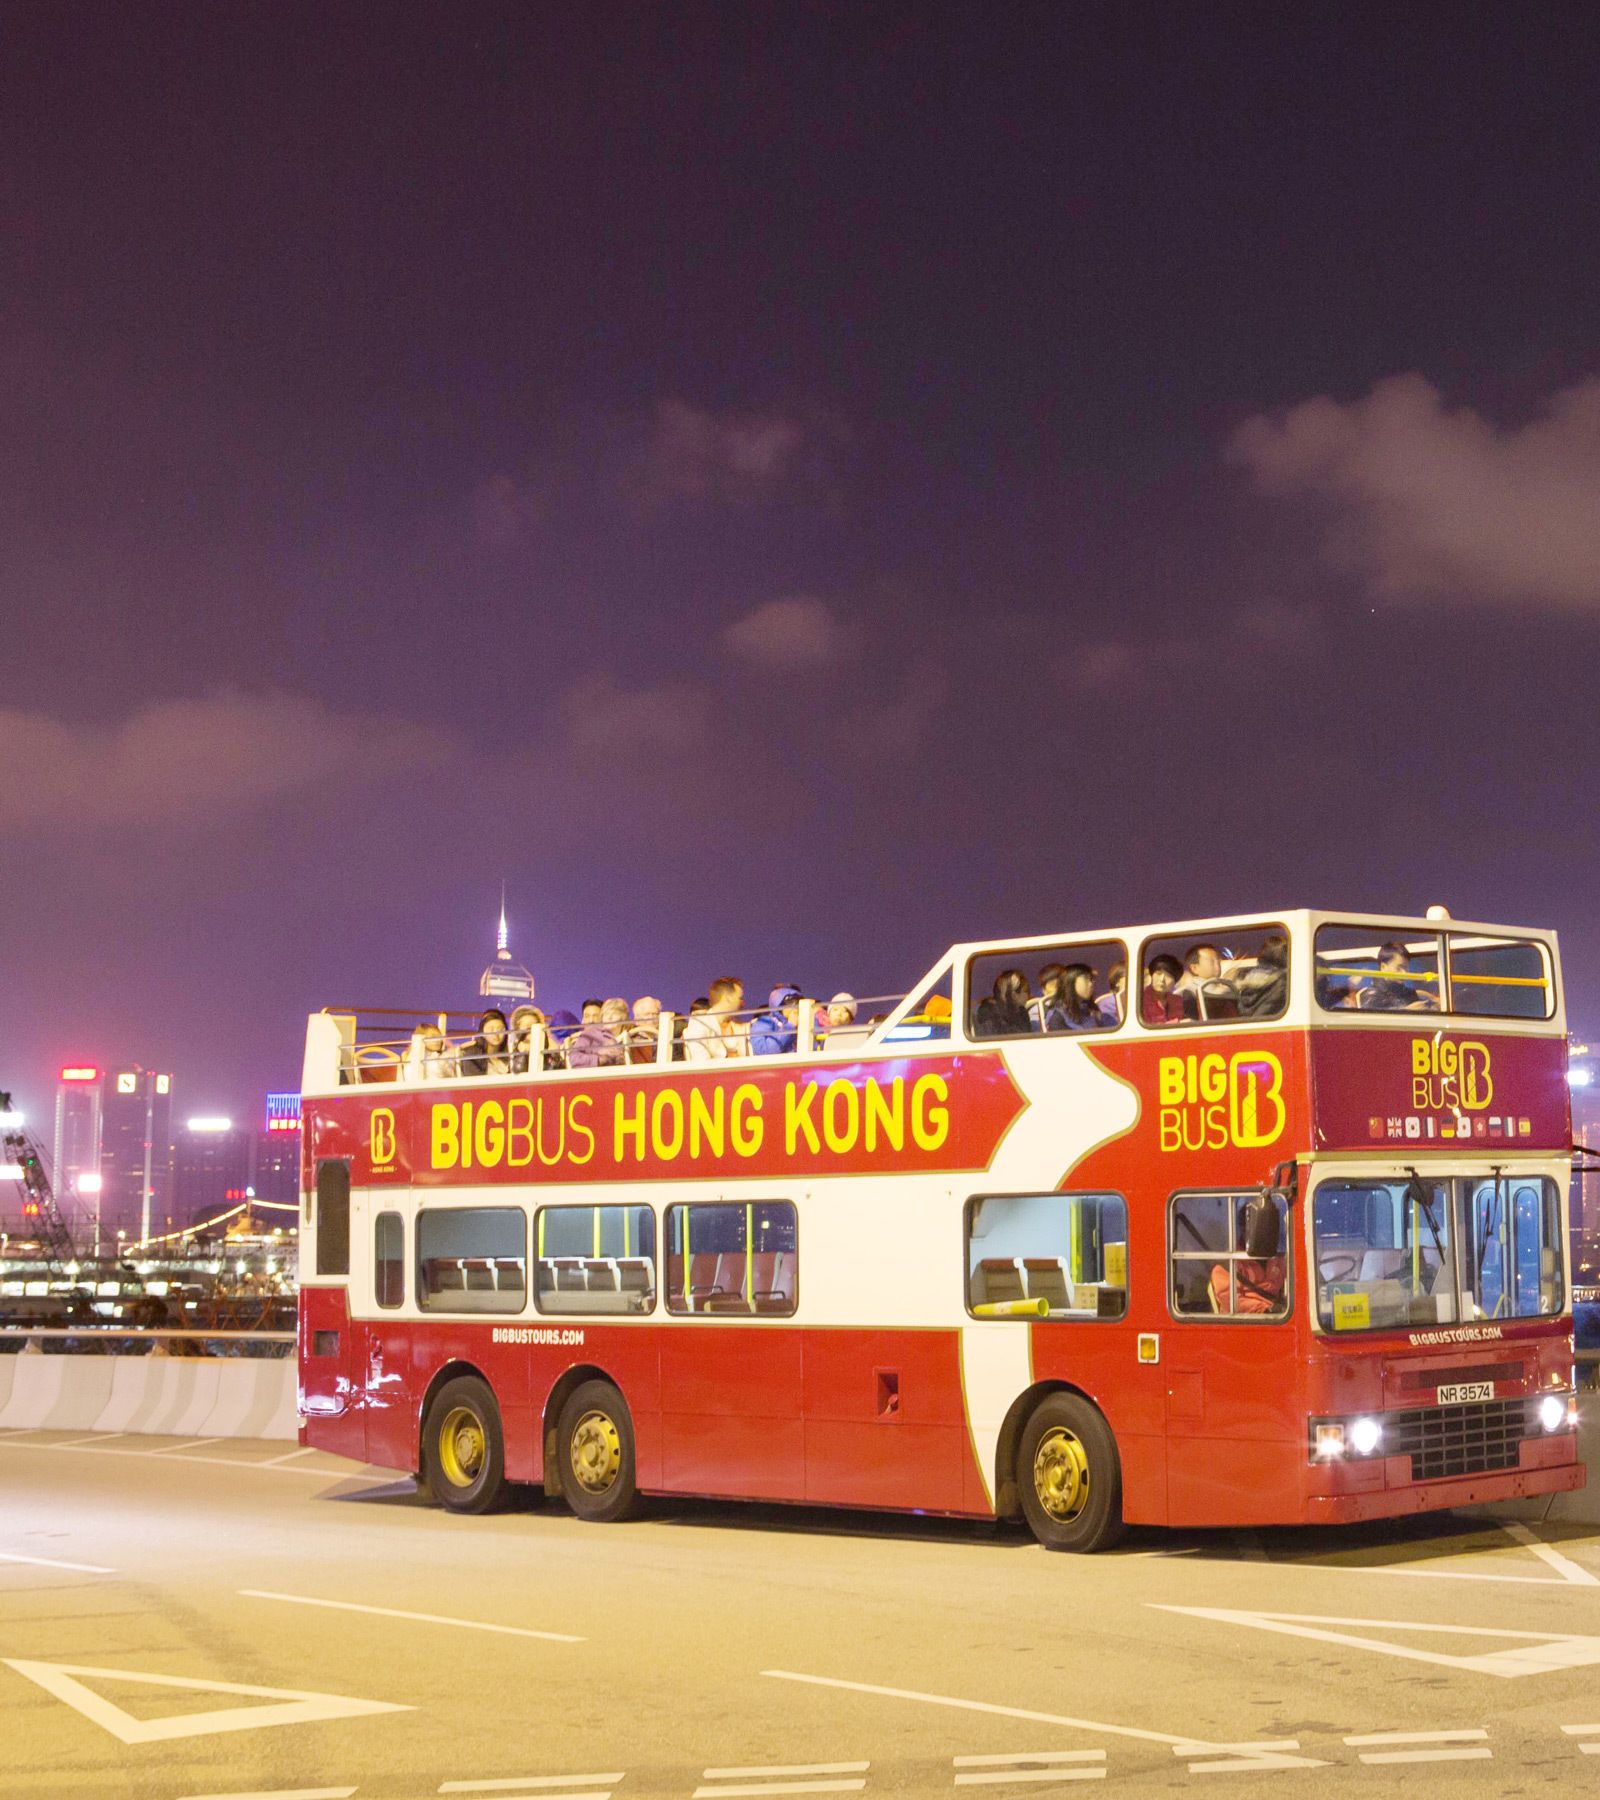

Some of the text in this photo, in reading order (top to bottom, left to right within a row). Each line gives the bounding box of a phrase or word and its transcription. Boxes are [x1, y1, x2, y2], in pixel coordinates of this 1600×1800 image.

[1412, 1039, 1457, 1075] BIG
[1159, 1053, 1227, 1105] BIG
[1413, 1077, 1459, 1110] BUS
[614, 1083, 764, 1162] HONG
[785, 1073, 949, 1156] KONG
[1160, 1105, 1228, 1152] BUS
[492, 1328, 585, 1345] BIGBUSTOURS.COM
[1408, 1326, 1503, 1346] BIGBUSTOURS.COM
[1439, 1385, 1490, 1401] NR 3574
